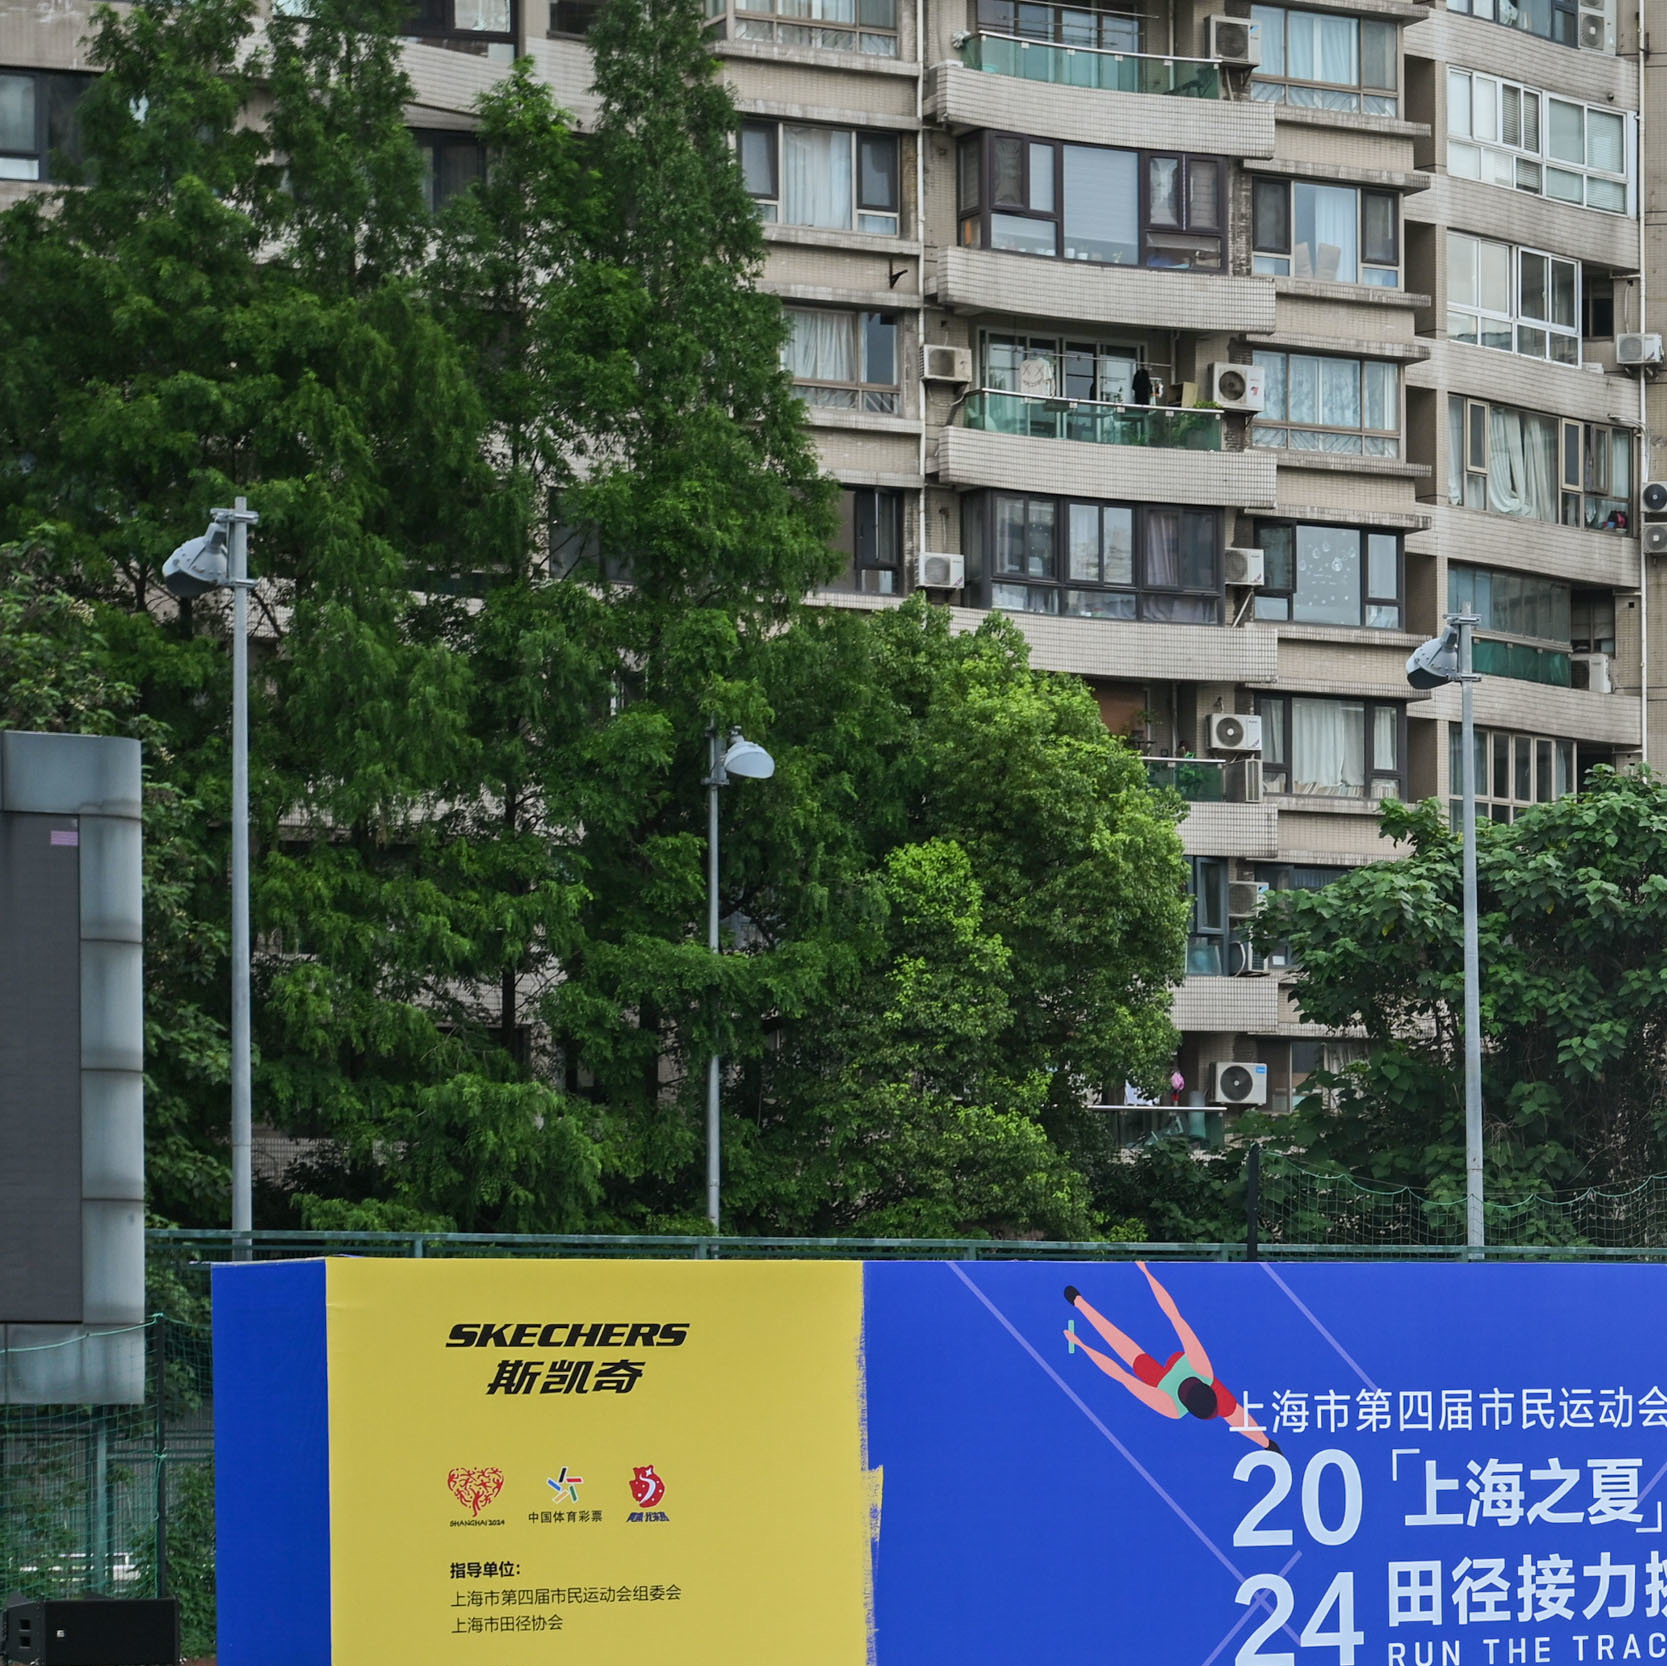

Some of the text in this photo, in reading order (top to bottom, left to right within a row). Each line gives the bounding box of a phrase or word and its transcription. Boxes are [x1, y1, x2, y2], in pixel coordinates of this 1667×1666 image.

[446, 1323, 690, 1347] SKECHERS
[485, 1359, 646, 1395] 斯凯奇
[1232, 1448, 1364, 1548] 20
[528, 1510, 604, 1524] 中国体育彩票
[450, 1561, 521, 1579] 指导单位：
[451, 1584, 682, 1608] 上海市第四届市民运动会组委会
[451, 1614, 563, 1634] 上海市田径协会
[1483, 1636, 1551, 1665] THE
